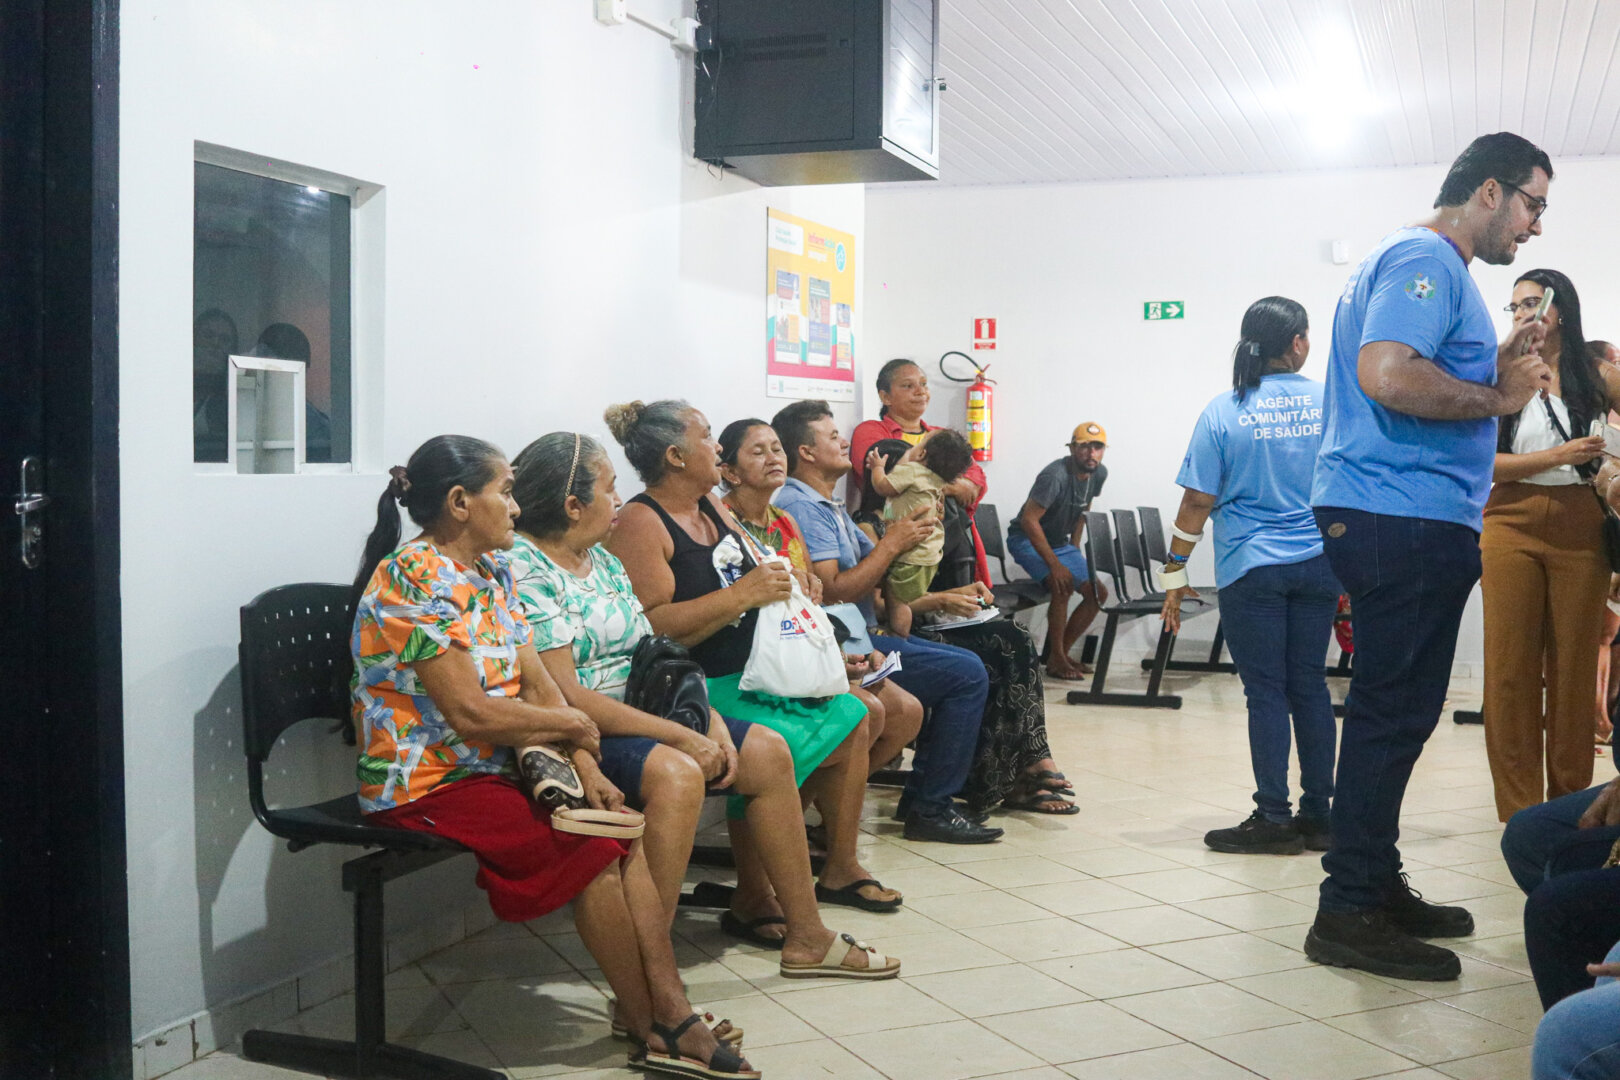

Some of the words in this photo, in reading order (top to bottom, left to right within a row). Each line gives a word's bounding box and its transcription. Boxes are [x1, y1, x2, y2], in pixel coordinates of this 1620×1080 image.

[1256, 395, 1313, 409] AGENTE
[1238, 407, 1323, 426] COMUNITÁRI
[1254, 427, 1272, 440] DE
[1274, 422, 1322, 438] SAÚDE
